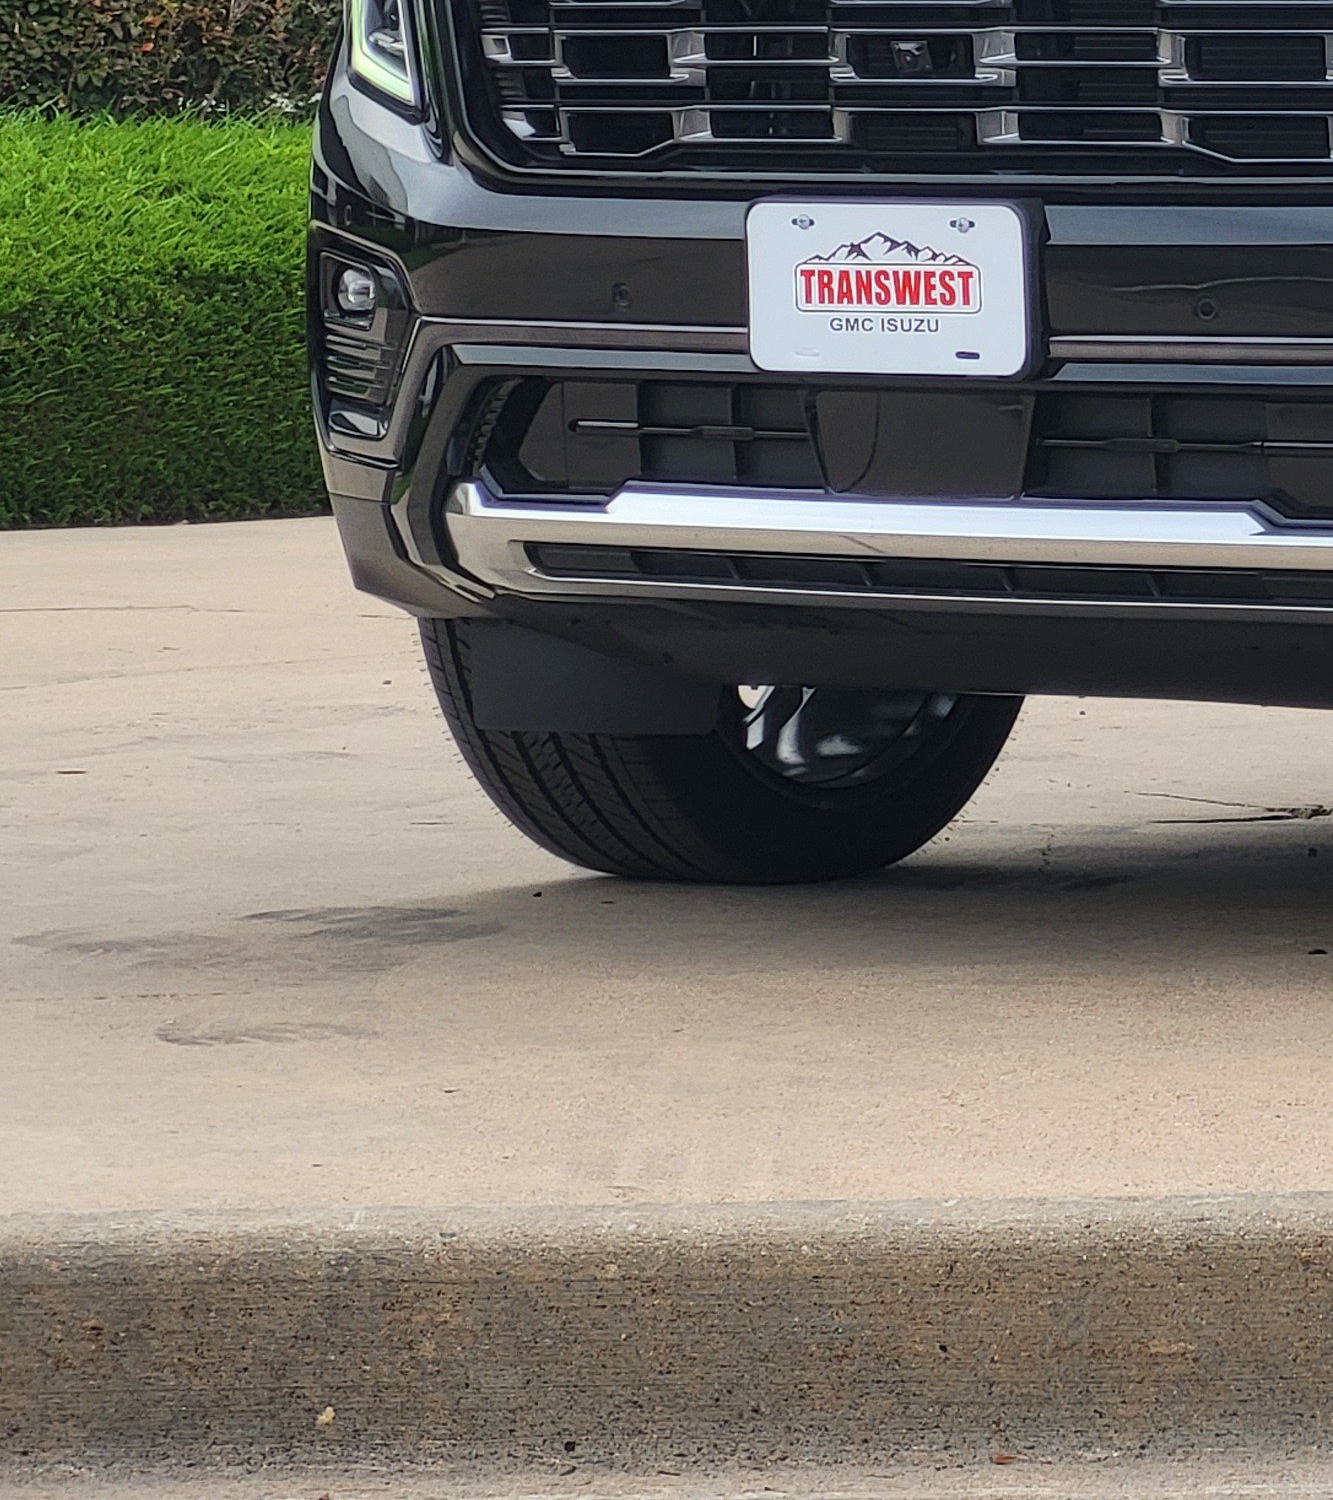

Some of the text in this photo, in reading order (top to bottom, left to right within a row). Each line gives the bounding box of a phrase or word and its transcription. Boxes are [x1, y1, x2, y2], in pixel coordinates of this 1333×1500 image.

[800, 269, 974, 306] TRANSWEST
[829, 317, 939, 333] GMC ISUZU
